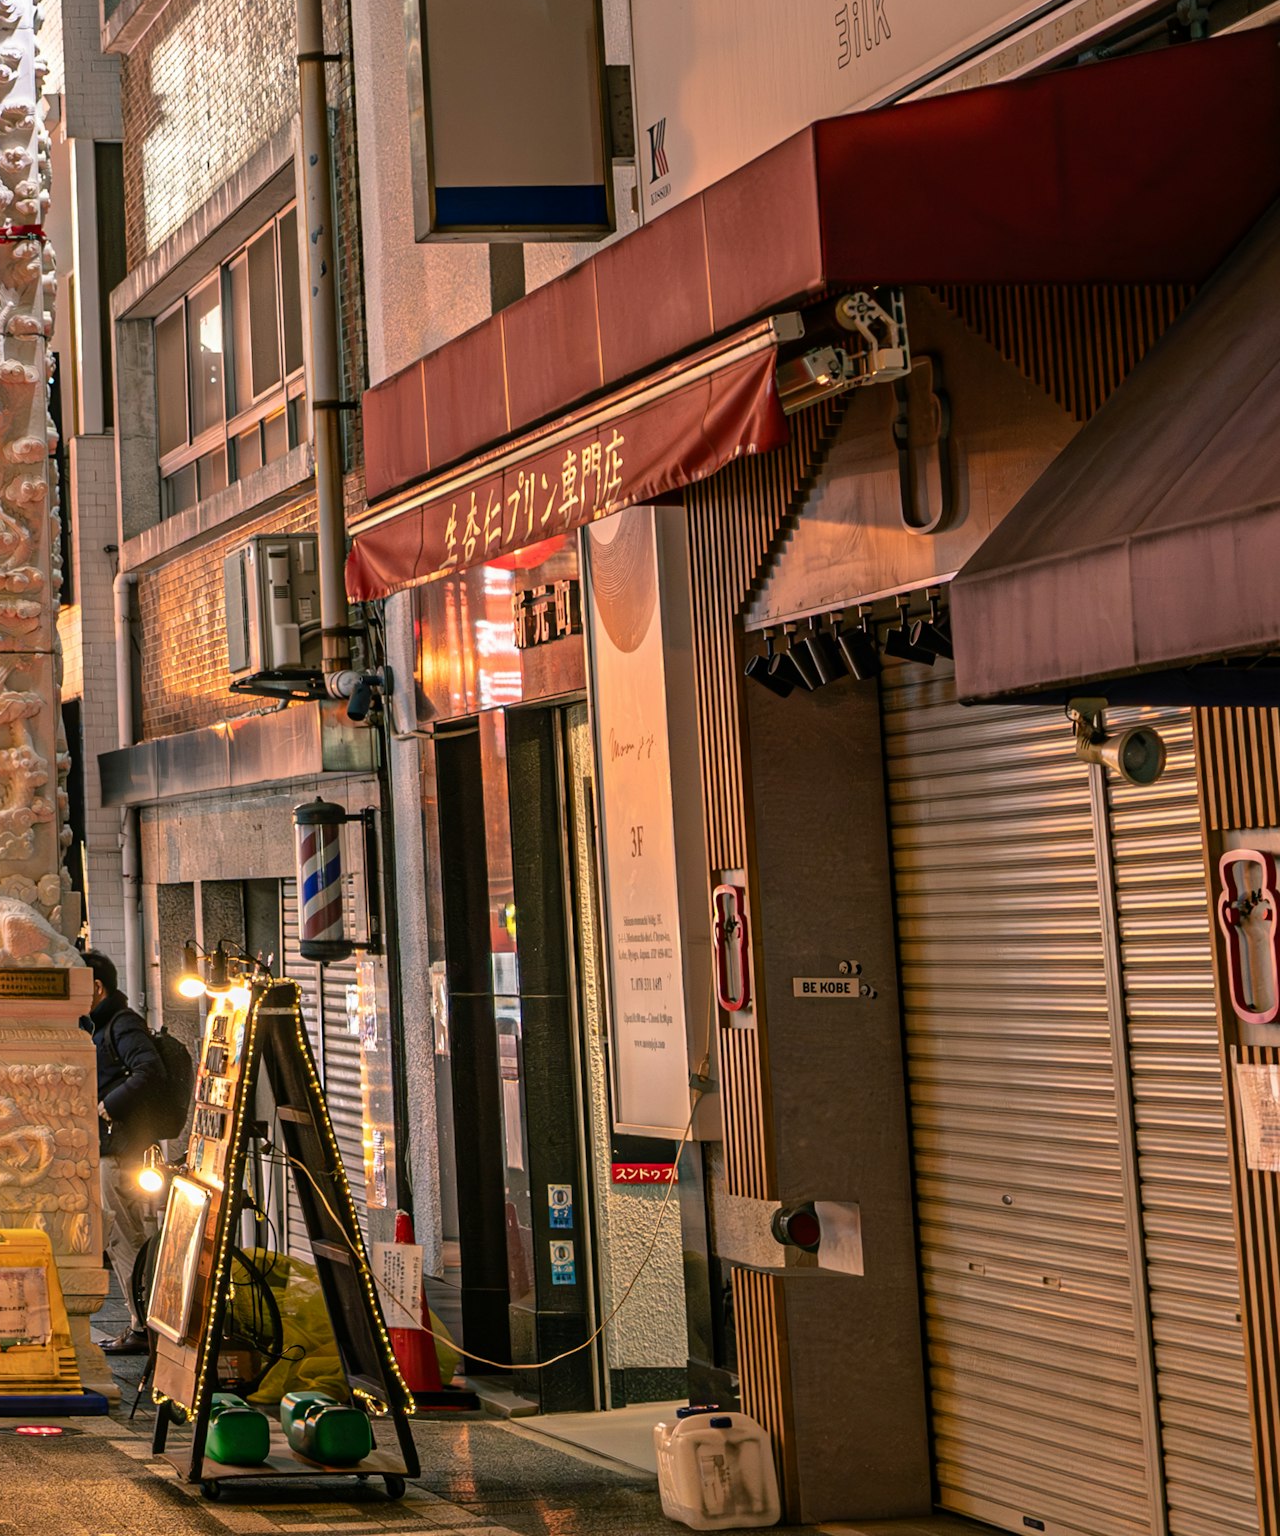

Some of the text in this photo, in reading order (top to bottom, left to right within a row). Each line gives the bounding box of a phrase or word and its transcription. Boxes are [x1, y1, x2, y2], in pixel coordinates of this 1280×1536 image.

[439, 428, 625, 570] 生杏仁プリン専門店
[630, 825, 644, 858] 3F
[802, 981, 851, 994] BE KOBE
